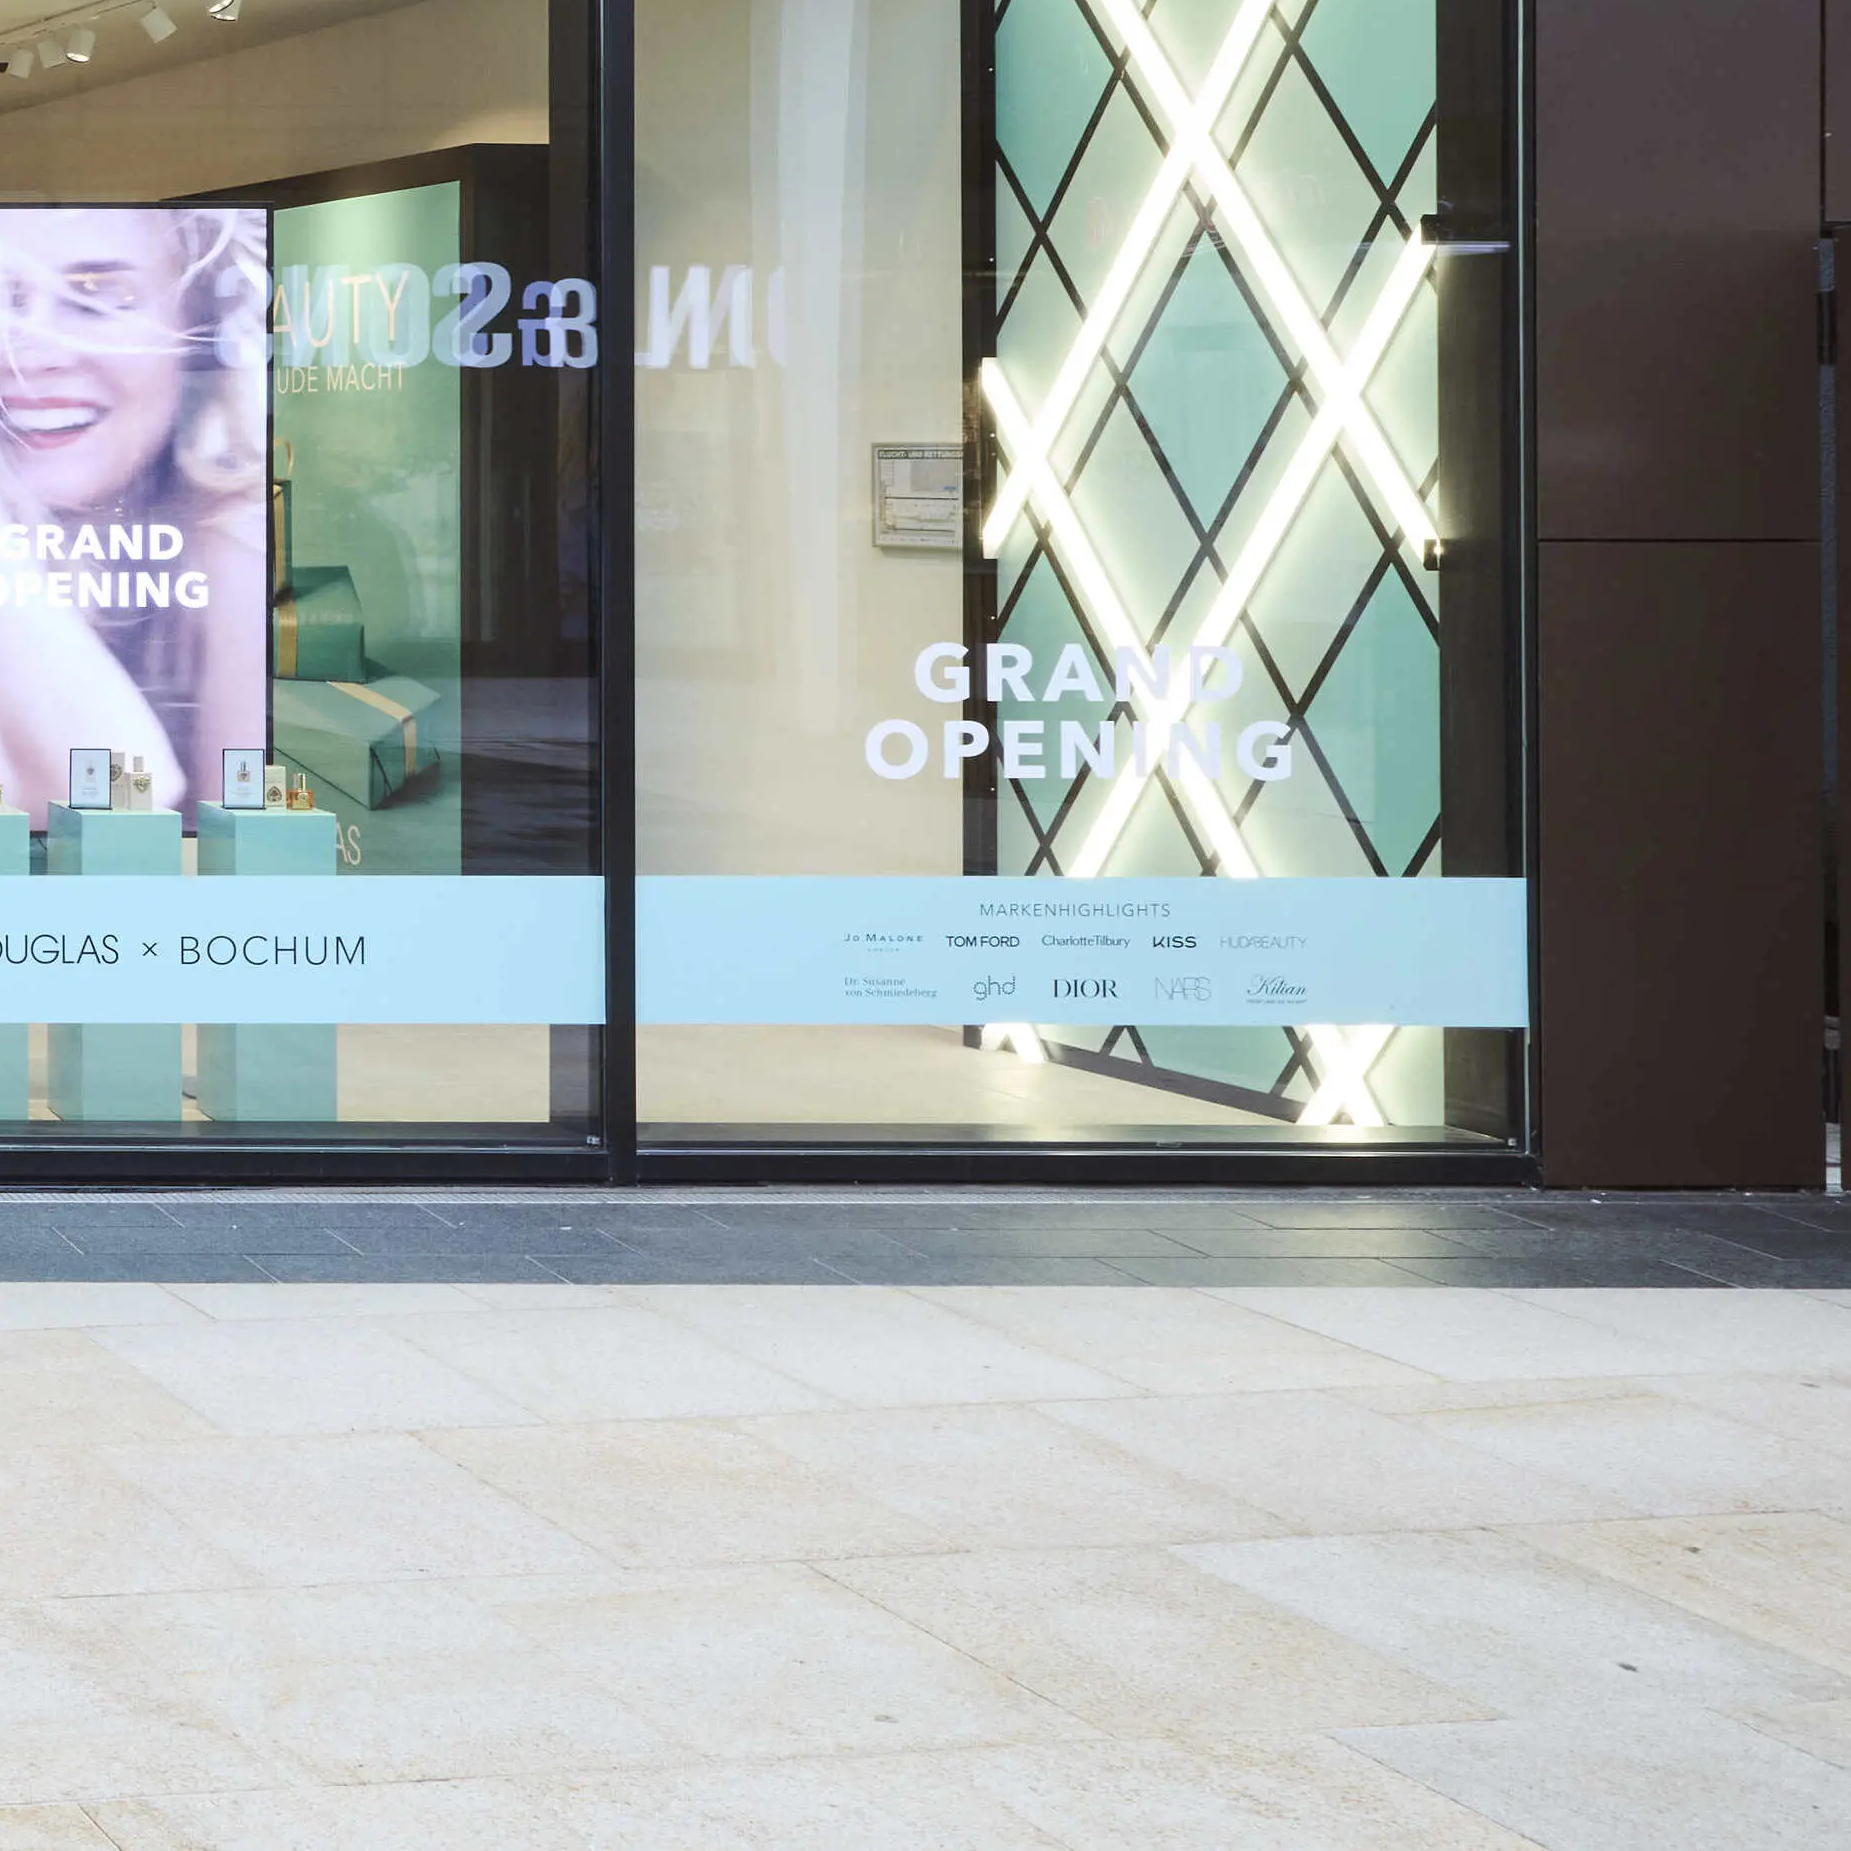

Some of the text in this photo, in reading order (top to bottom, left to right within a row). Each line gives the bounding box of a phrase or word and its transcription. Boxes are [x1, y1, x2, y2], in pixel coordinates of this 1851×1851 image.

[327, 360, 407, 392] MACHT
[2, 524, 184, 561] GRAND
[913, 641, 1244, 703] GRAND
[864, 718, 1293, 781] OPENING
[979, 903, 1171, 918] MARKENHIGHLIGHTS
[180, 935, 366, 966] BOCHUM
[946, 935, 1020, 948] TOM FORD
[1152, 935, 1198, 949] KISS
[973, 975, 1017, 1001] ghd
[1053, 978, 1119, 999] DIOR
[1246, 974, 1308, 997] Kilian
